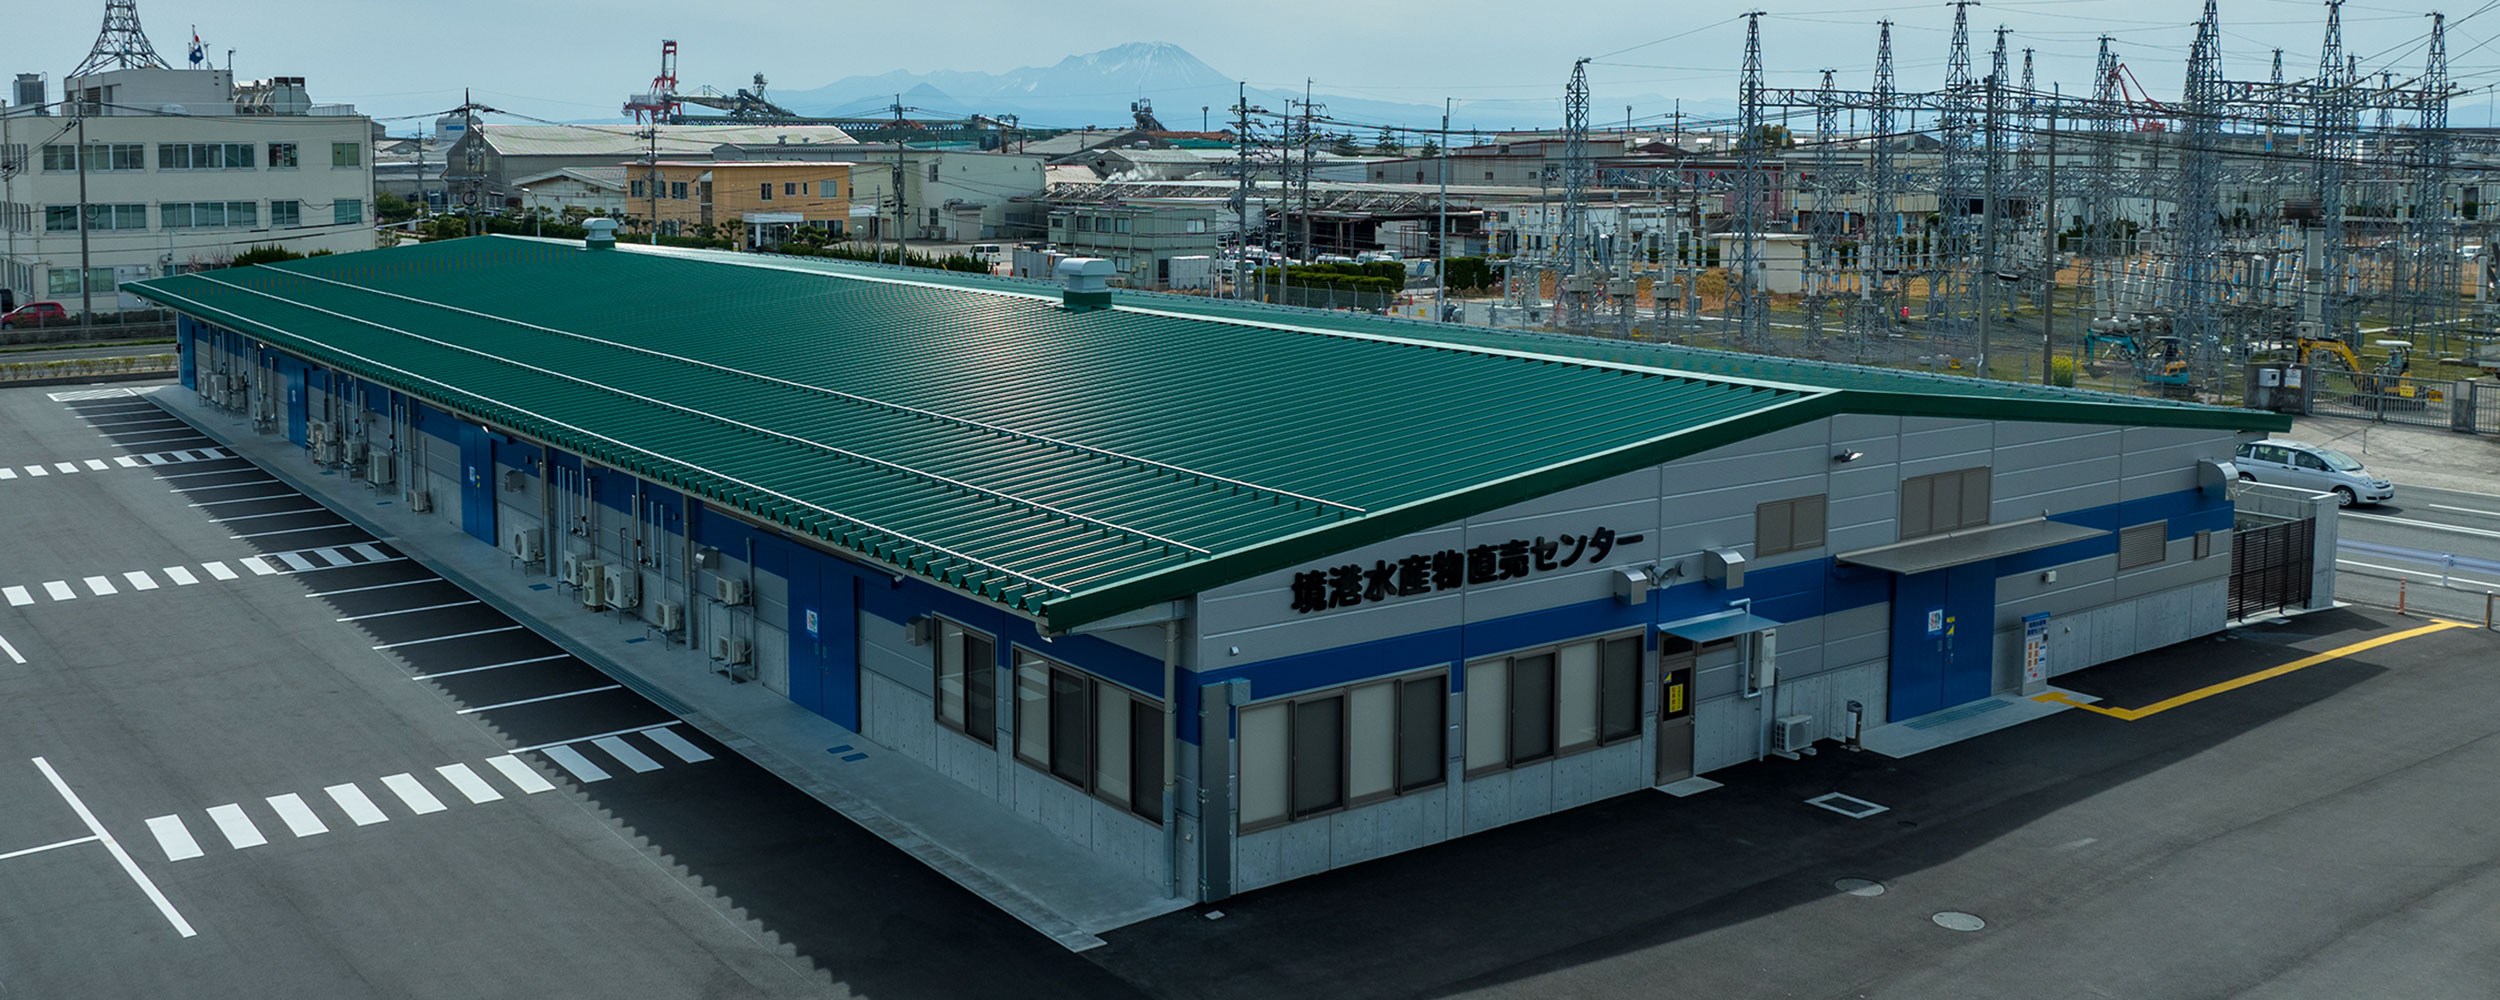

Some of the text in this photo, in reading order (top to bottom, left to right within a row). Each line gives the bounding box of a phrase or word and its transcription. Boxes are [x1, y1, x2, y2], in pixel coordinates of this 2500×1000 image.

[1291, 527, 1643, 613] 境港水産物直売センター
